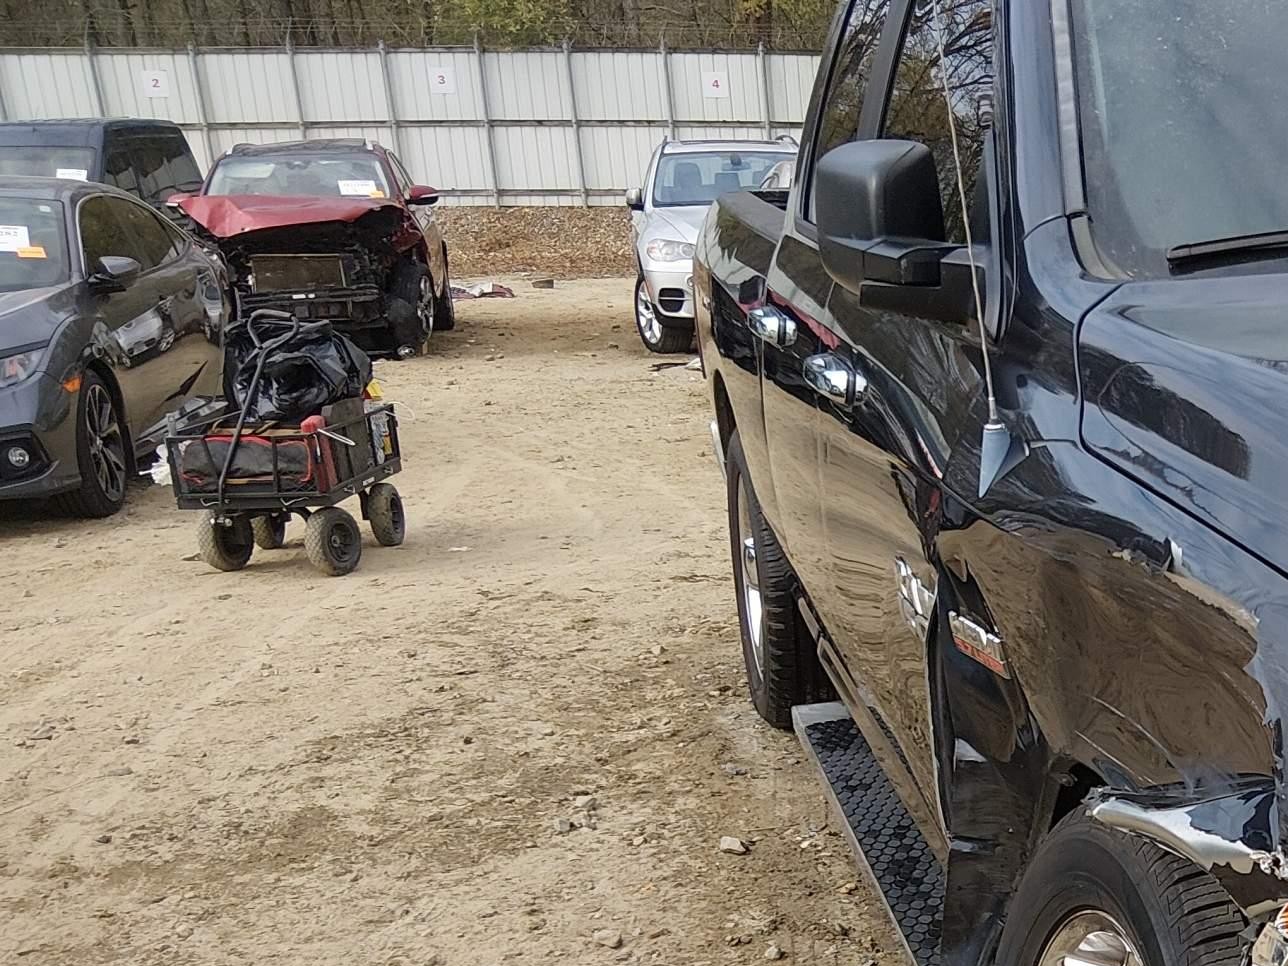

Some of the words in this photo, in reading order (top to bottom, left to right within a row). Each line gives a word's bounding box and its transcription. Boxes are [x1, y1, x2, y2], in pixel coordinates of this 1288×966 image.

[152, 79, 160, 87] 2
[438, 76, 446, 85] 3
[712, 80, 720, 89] 4
